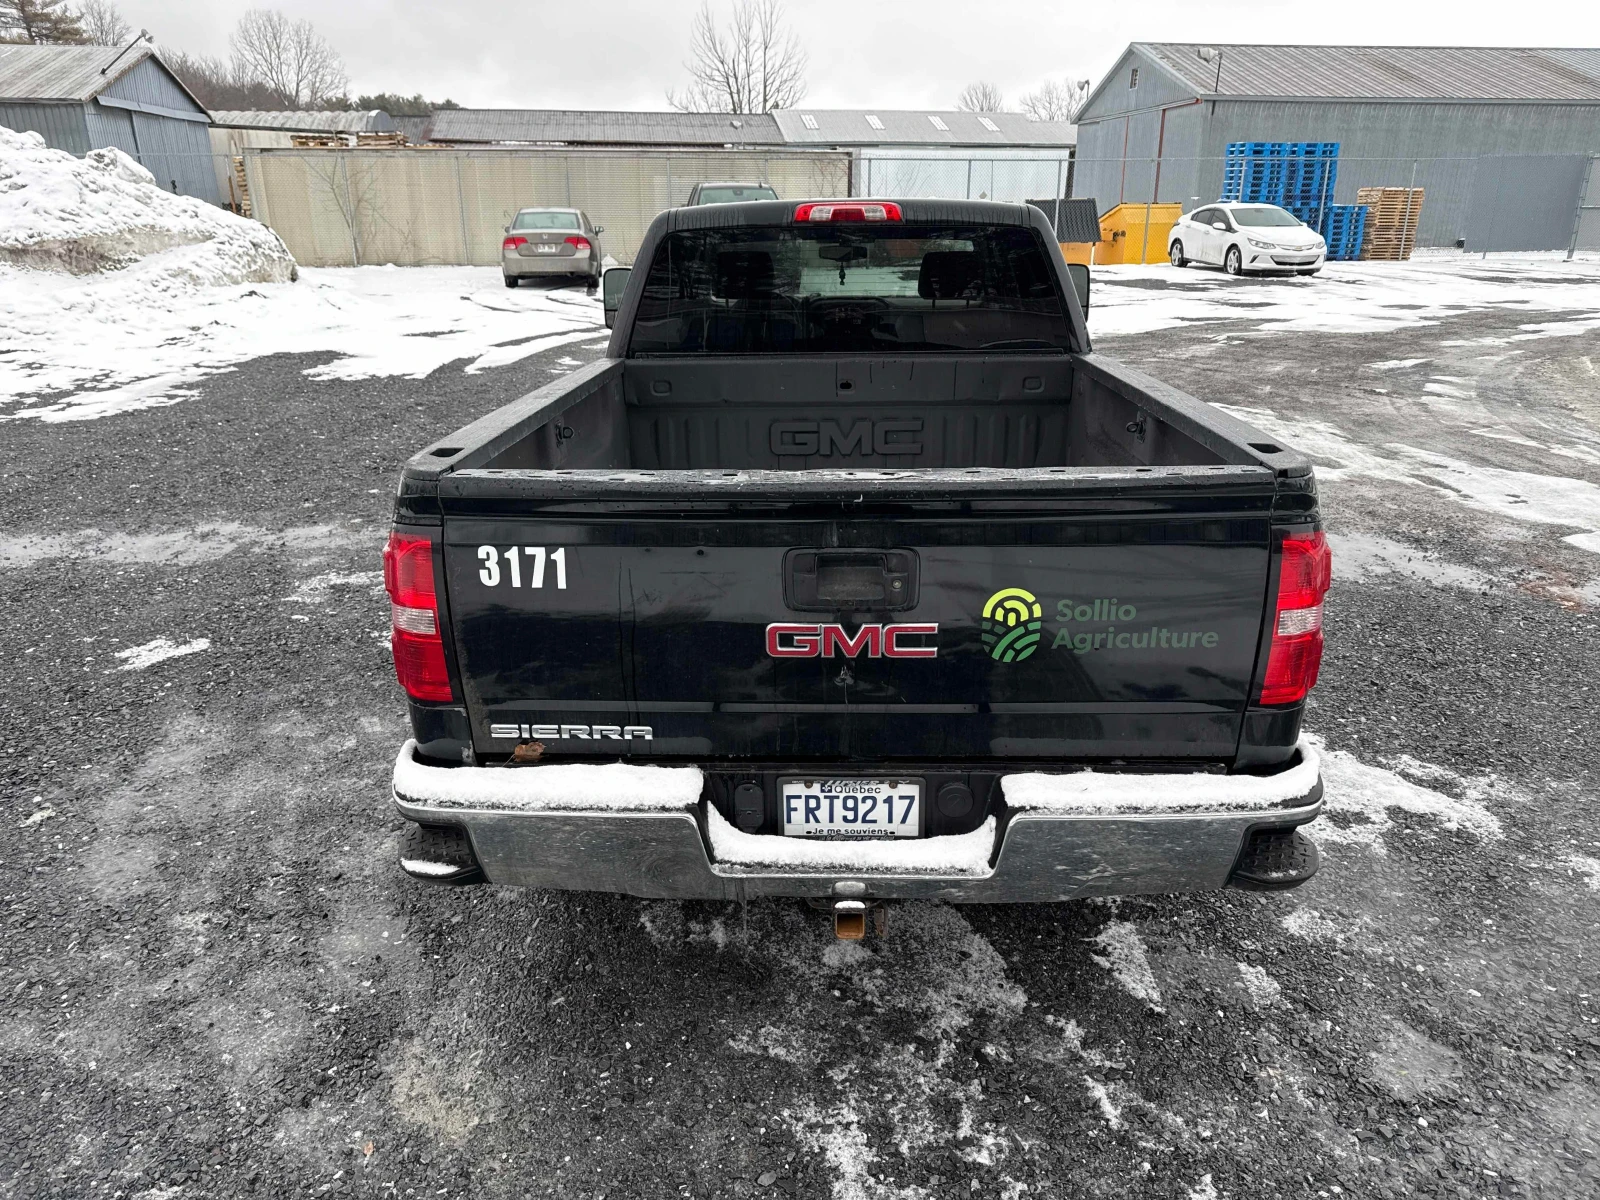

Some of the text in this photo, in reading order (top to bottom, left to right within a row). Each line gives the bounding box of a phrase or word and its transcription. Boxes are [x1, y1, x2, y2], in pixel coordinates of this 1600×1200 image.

[769, 418, 924, 457] GMC
[477, 545, 567, 589] 3171
[1056, 598, 1137, 622] Sollio
[765, 622, 939, 659] GMC
[1051, 627, 1219, 654] Agriculture
[490, 723, 653, 740] SIERRA
[785, 795, 916, 824] FRT9217
